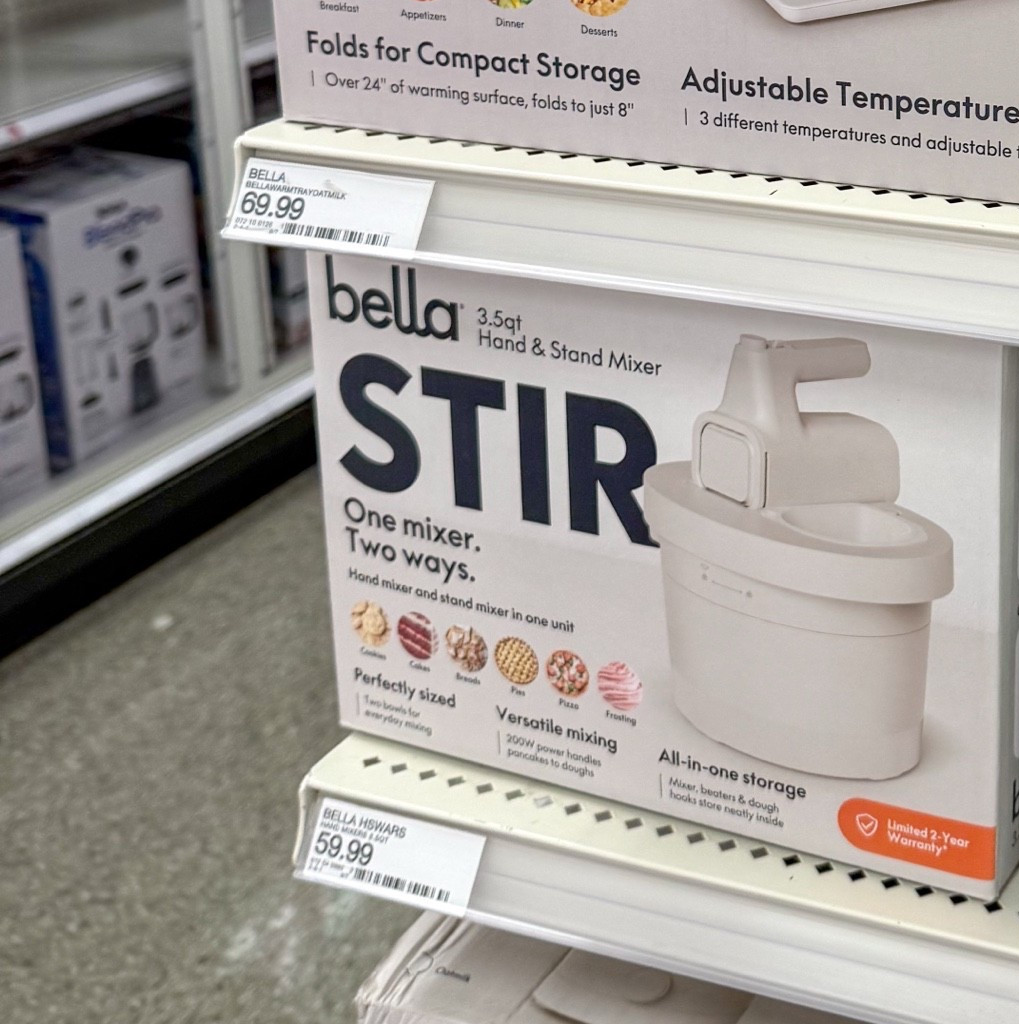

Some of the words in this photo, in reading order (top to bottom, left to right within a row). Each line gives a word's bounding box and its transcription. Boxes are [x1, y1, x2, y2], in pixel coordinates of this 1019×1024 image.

[320, 1, 360, 14] Breakfast
[400, 9, 447, 22] Appetizers
[495, 17, 525, 29] Dinner
[581, 25, 618, 38] Desserts
[307, 30, 369, 59] Folds
[375, 37, 410, 63] for
[417, 41, 530, 77] Compact
[537, 53, 641, 92] Storage
[325, 72, 360, 90] Over
[363, 75, 386, 91] 24"
[391, 78, 405, 94] of
[408, 85, 470, 105] warming
[473, 90, 529, 109] surface,
[532, 93, 568, 112] folds
[571, 98, 586, 113] to
[589, 101, 614, 118] just
[681, 66, 829, 105] Adjustable
[700, 111, 709, 125] 3
[713, 112, 778, 133] different
[783, 120, 886, 145] temperatures
[890, 133, 921, 148] and
[926, 136, 1012, 158] adjustable
[245, 181, 348, 200] BELLAWARMTRAYOATMILK
[249, 168, 286, 183] BELLA
[241, 191, 305, 220] 69.99
[325, 254, 459, 341] bella
[477, 307, 522, 332] 3.5qt
[478, 330, 526, 353] Hand
[532, 337, 546, 356] &
[551, 341, 603, 367] Stand
[608, 350, 662, 376] Mixer
[339, 353, 660, 548] STIR
[344, 498, 396, 531] One
[403, 517, 481, 552] mixer.
[346, 527, 396, 562] Two
[402, 548, 475, 583] ways.
[659, 749, 739, 781] All-in-one
[743, 772, 807, 800] storage
[323, 807, 356, 826] BELLA
[359, 817, 407, 839] HSWARS
[888, 819, 928, 839] Limited
[931, 829, 970, 849] 2-Year
[315, 831, 374, 866] 59.99
